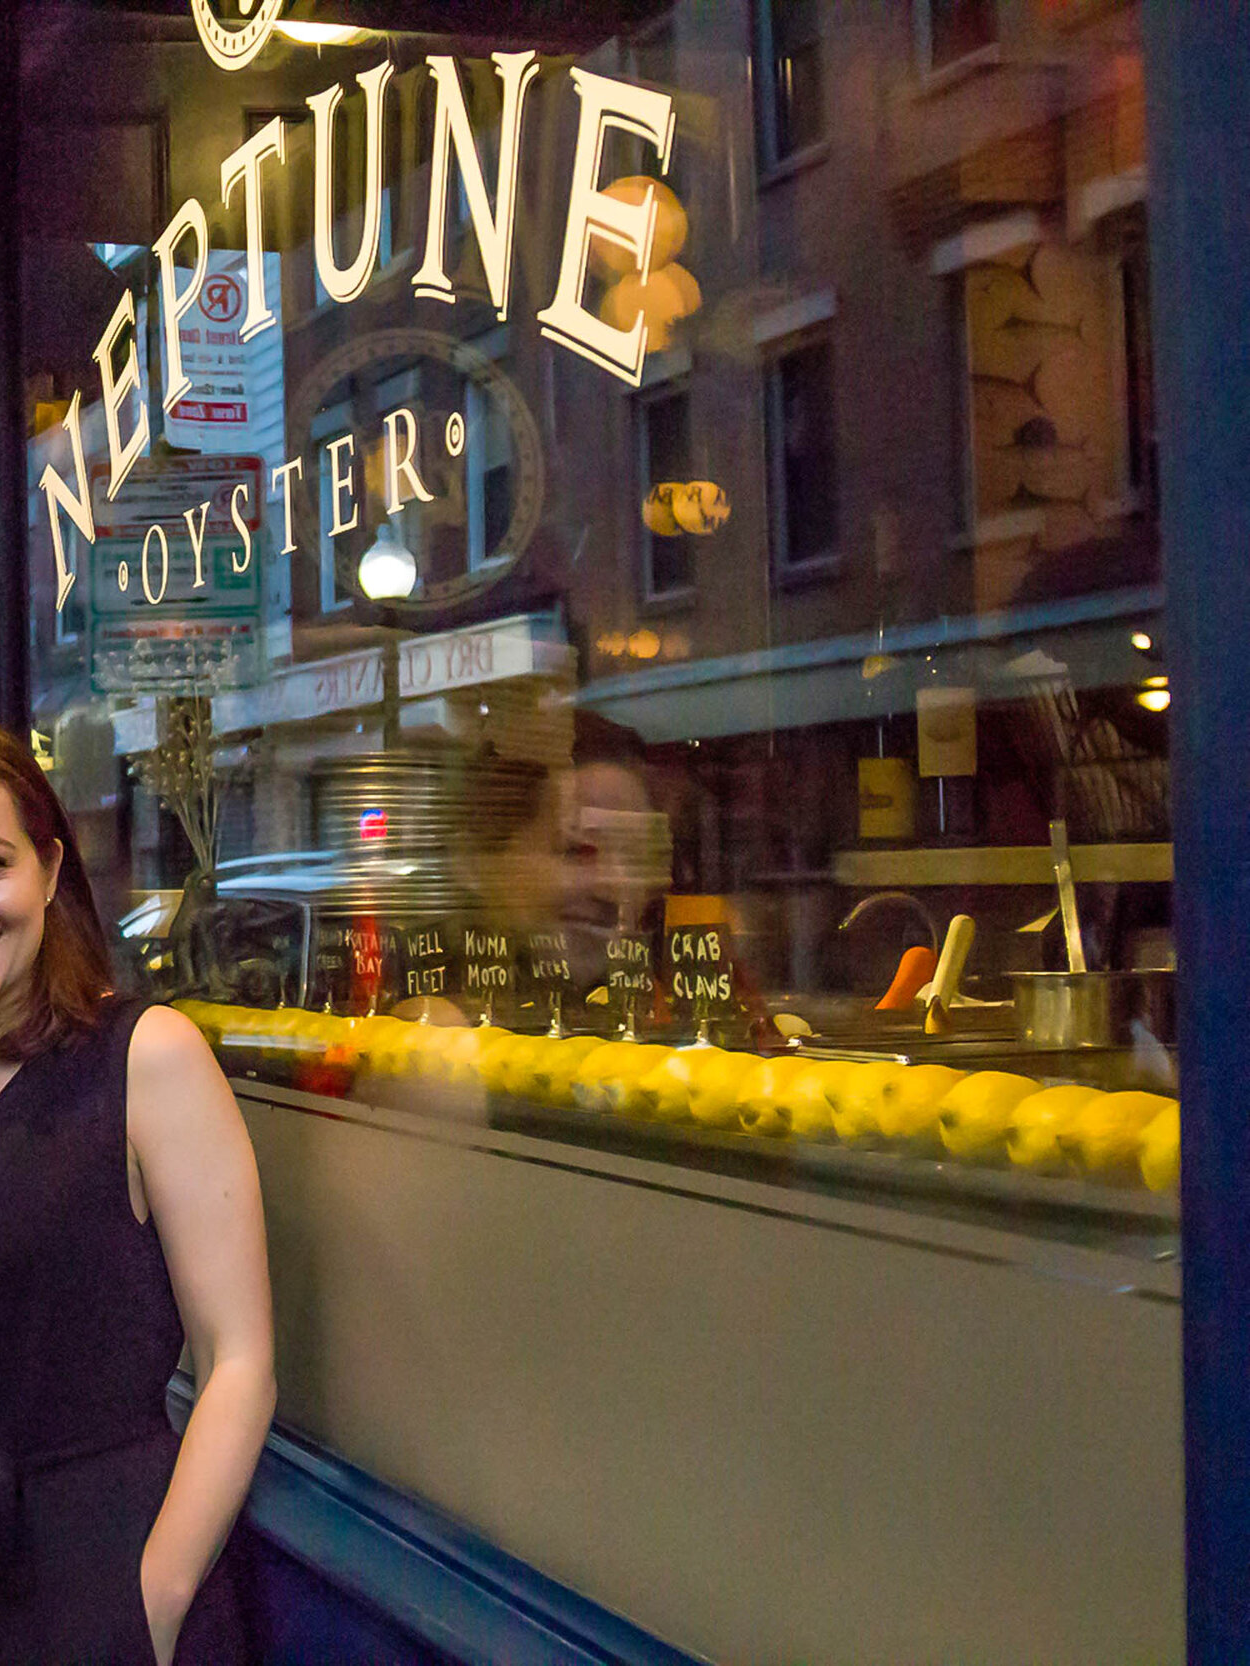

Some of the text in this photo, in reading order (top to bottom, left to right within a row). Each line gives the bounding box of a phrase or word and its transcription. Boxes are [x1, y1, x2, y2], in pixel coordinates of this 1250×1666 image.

[38, 50, 676, 613] NEPTUNE
[141, 408, 434, 604] OYSTER
[407, 930, 444, 957] WELL
[465, 930, 508, 958] KUMA
[671, 931, 721, 962] CRAB
[356, 955, 383, 977] BAY
[468, 963, 507, 988] MOTO
